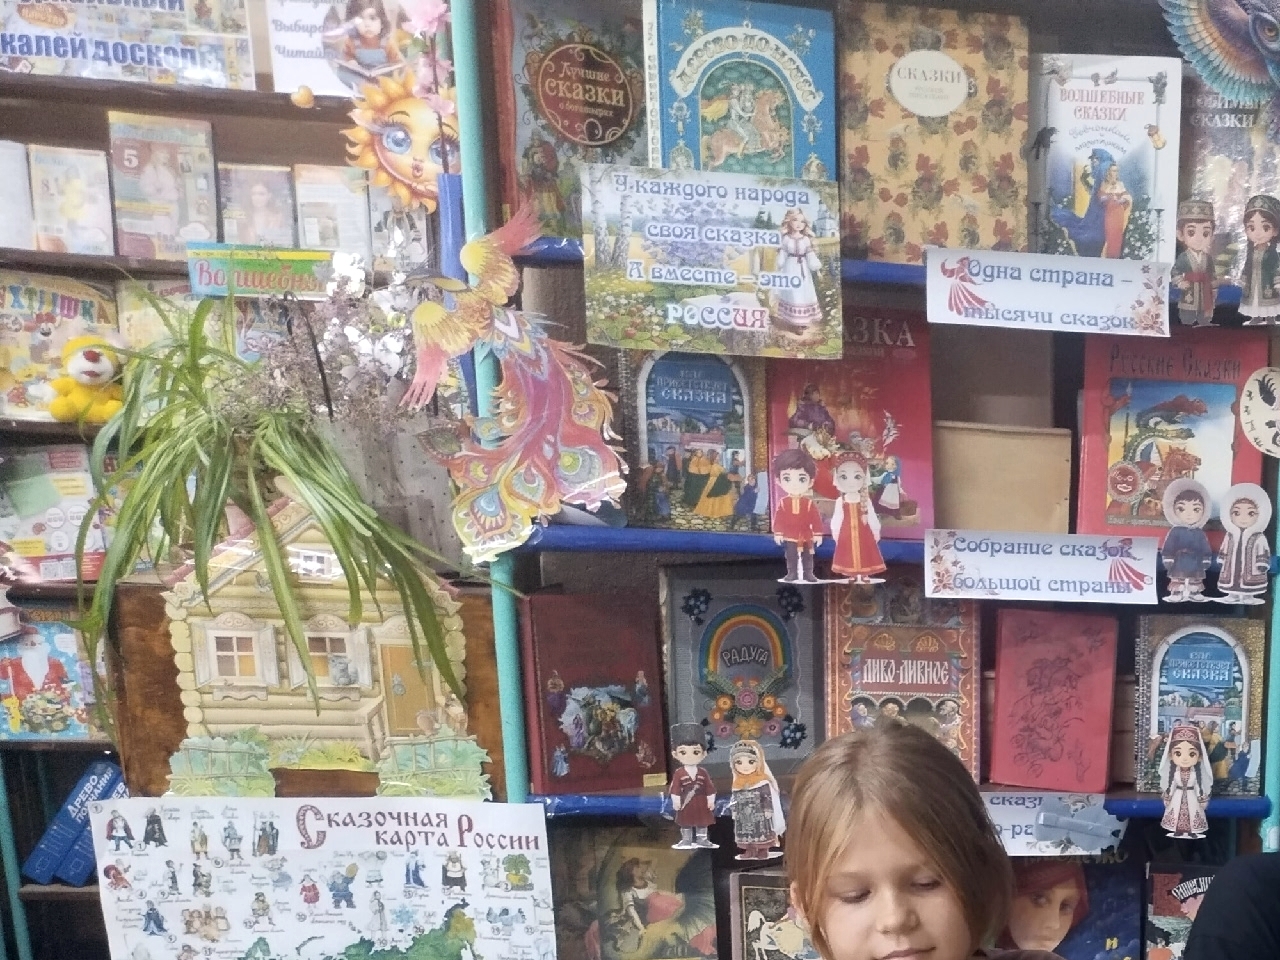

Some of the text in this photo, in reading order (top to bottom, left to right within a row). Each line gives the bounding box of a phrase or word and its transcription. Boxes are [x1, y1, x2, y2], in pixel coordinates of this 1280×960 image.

[558, 61, 611, 81] Лучшие
[896, 67, 962, 84] СКАЗКИ
[545, 76, 625, 107] сказки
[1060, 87, 1144, 106] ВОЛШЕБНЫЕ
[1074, 106, 1127, 122] СКАЗКИ
[1190, 113, 1254, 128] СКАЗКИ
[123, 149, 139, 168] 5
[614, 175, 810, 207] У каждого народа
[647, 224, 781, 247] своя сказка
[627, 262, 801, 289] А вместе это
[968, 260, 1113, 289] Одна страна
[964, 306, 1135, 331] тысячи сказок
[1110, 344, 1241, 380] Русские Сказки
[661, 388, 727, 404] СКАЗКА
[952, 537, 1134, 560] Собрание сказок
[953, 574, 1133, 596] большой страны
[722, 644, 769, 666] РАДУГА
[1173, 669, 1229, 680] СКАЗКА
[67, 775, 98, 819] ДРЕВО
[75, 767, 114, 823] ПОНАНИЯ
[296, 803, 449, 850] Сказочная
[375, 815, 540, 852] карта России
